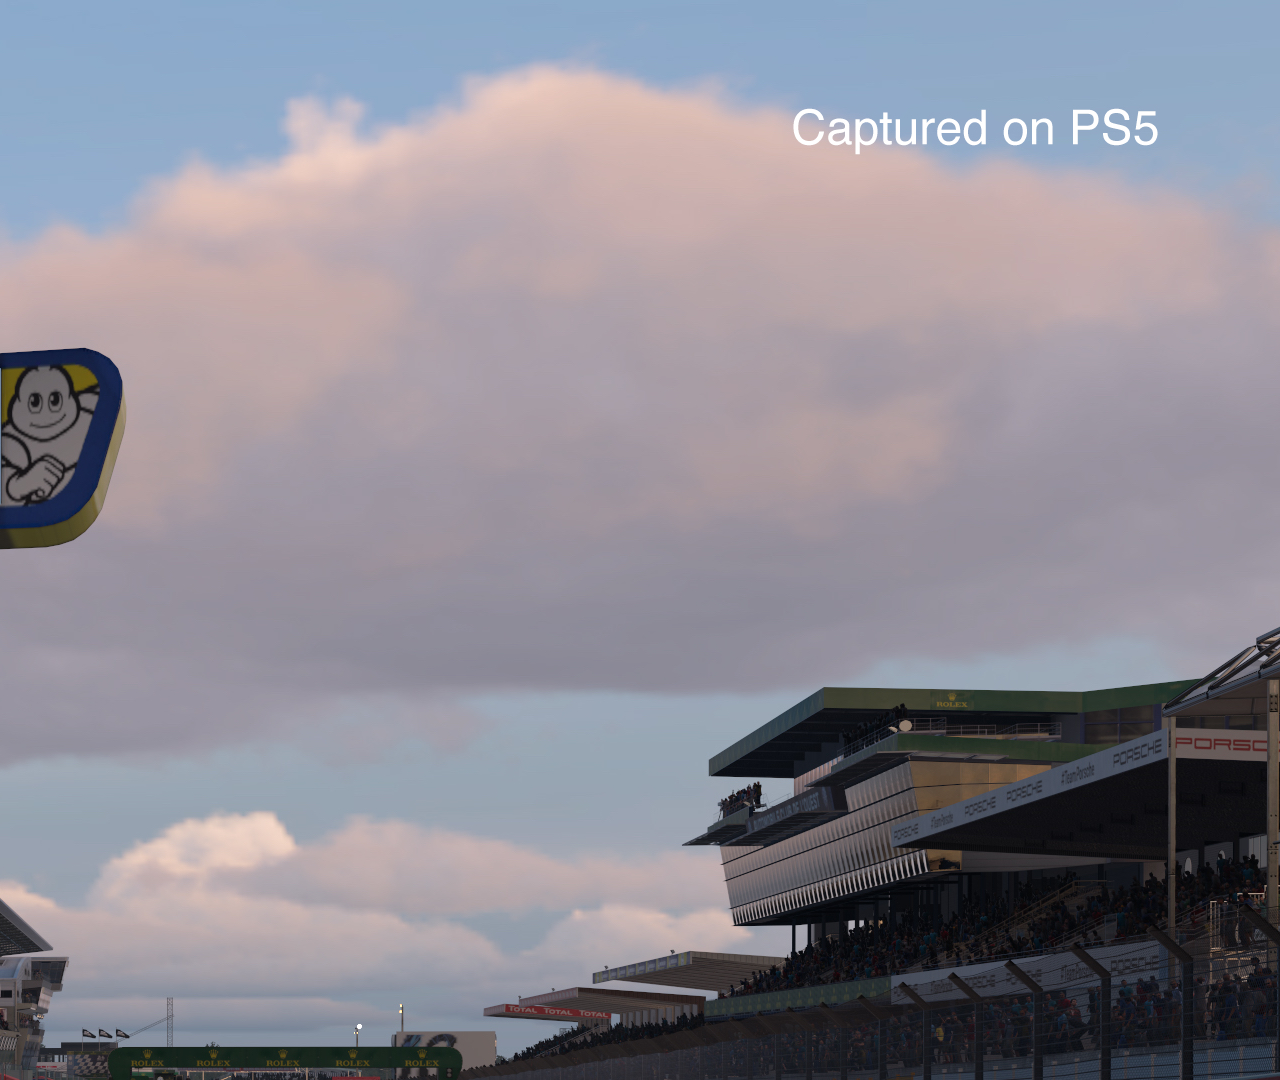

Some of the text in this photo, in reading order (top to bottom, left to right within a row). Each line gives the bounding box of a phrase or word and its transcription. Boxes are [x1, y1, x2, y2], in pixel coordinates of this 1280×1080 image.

[937, 700, 968, 708] ROLEX
[1176, 737, 1268, 752] PORSC
[1113, 738, 1162, 768] PORSCHE
[1006, 780, 1042, 805] PORSCHE
[965, 796, 996, 818] PORSCHE
[508, 1005, 538, 1014] TOTAL
[543, 1007, 573, 1016] TOTAL
[579, 1009, 609, 1018] TOTAL
